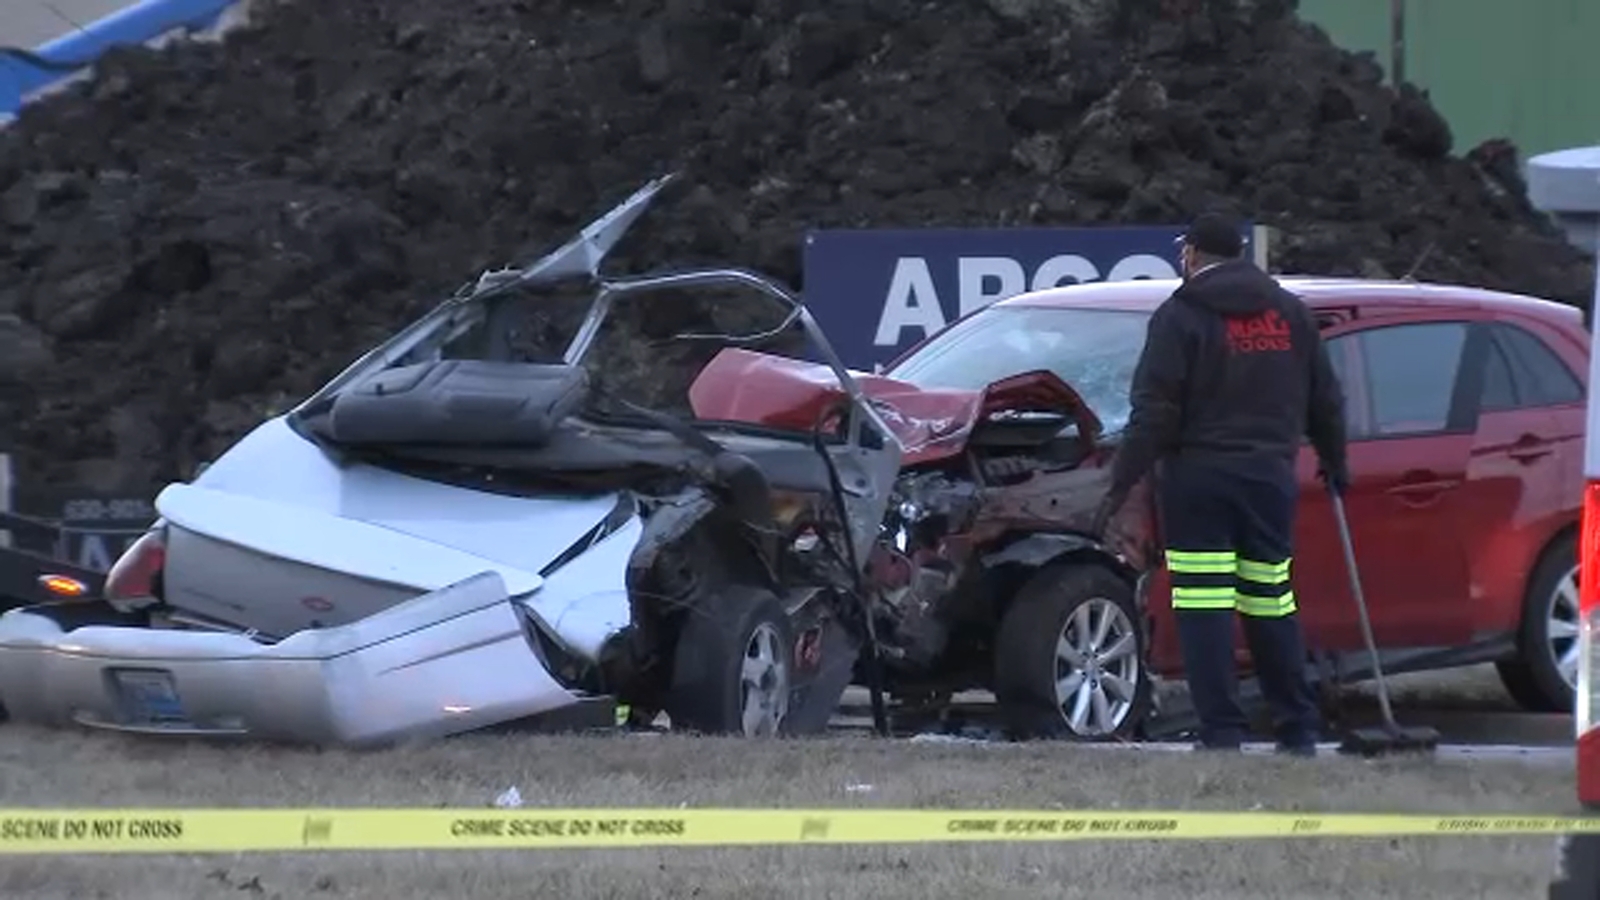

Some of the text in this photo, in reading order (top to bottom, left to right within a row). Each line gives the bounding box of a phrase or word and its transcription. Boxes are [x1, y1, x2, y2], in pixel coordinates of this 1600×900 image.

[1227, 338, 1291, 353] TOOLS
[1, 819, 183, 839] SCENE DO NOT CROSS
[451, 819, 685, 836] CRIME SCENE DO NOT CROSS
[947, 819, 1179, 833] CRIME SCENE DO NOT CROSS
